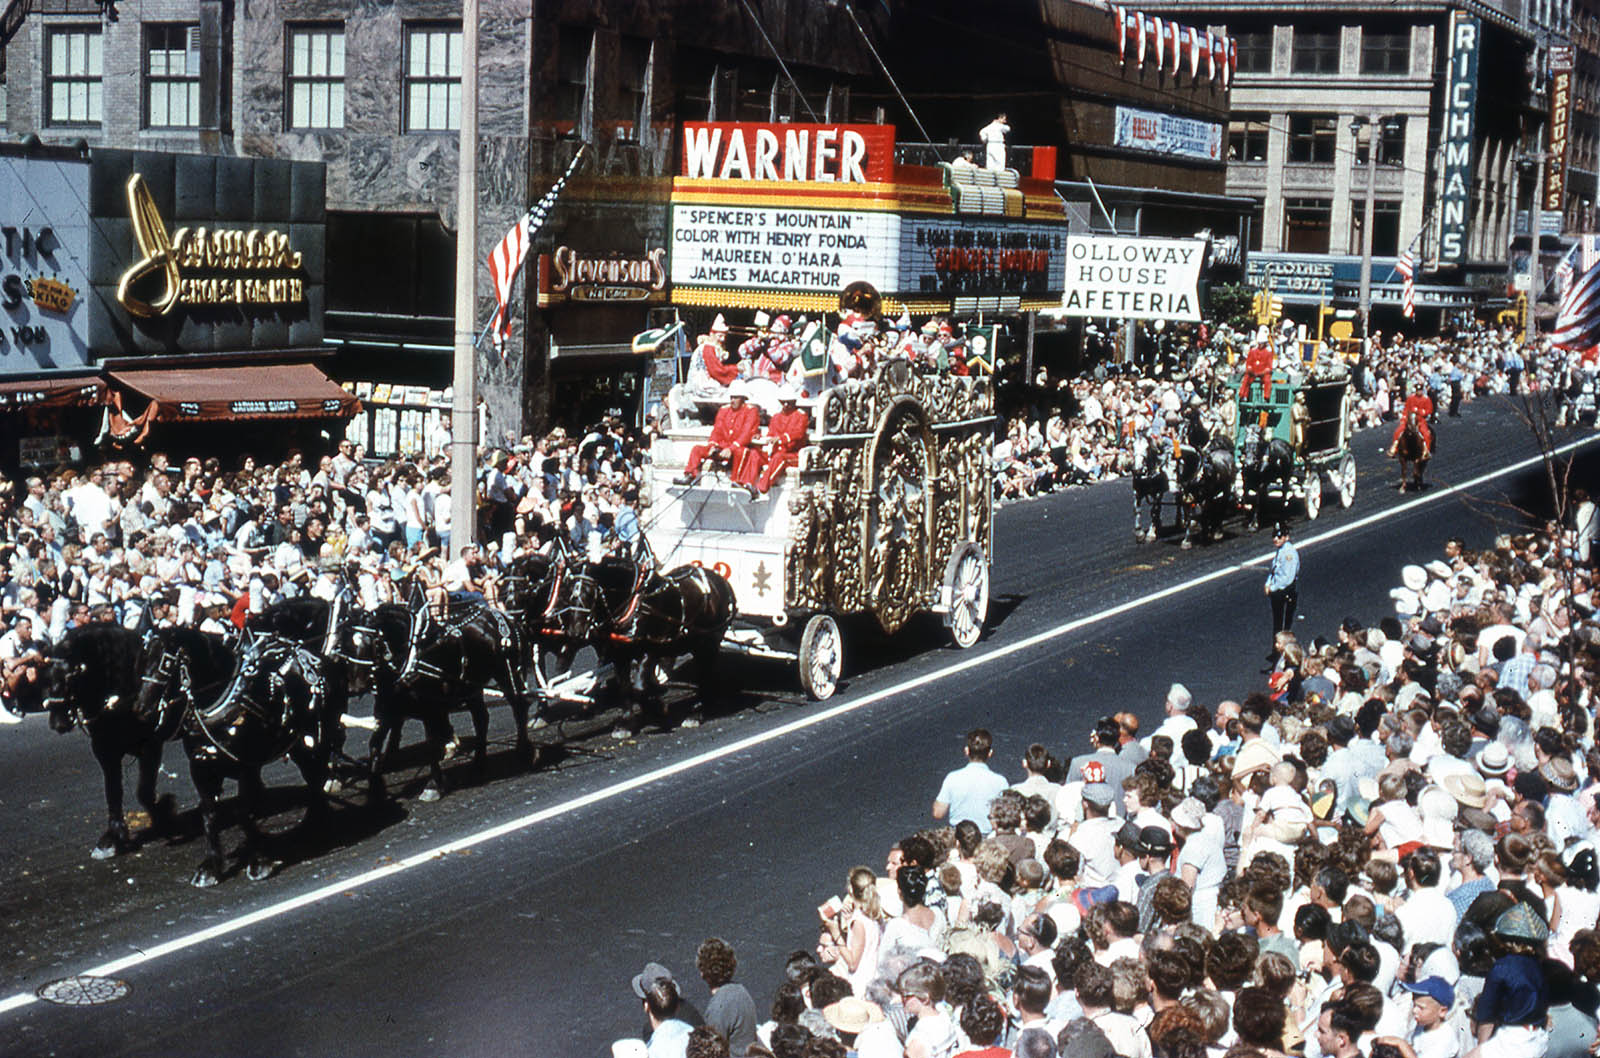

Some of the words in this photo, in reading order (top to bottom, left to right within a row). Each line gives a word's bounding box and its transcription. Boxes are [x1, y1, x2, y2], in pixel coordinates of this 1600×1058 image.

[1443, 23, 1475, 258] RICHMAN'S
[685, 126, 866, 184] WARNER
[675, 228, 719, 243] COLOR
[725, 230, 759, 244] WITH
[766, 231, 811, 247] HENRY
[818, 233, 867, 249] FONDA
[701, 248, 772, 265] MAUREEN
[781, 252, 842, 268] O'HARA
[1072, 243, 1194, 265] OLLOWAY
[689, 267, 736, 281] JAMES
[748, 269, 840, 287] MACARTHUR
[1079, 265, 1167, 285] HOUSE
[1286, 276, 1322, 292] 1879
[36, 292, 69, 309] KING
[1066, 289, 1192, 315] AFETERIA
